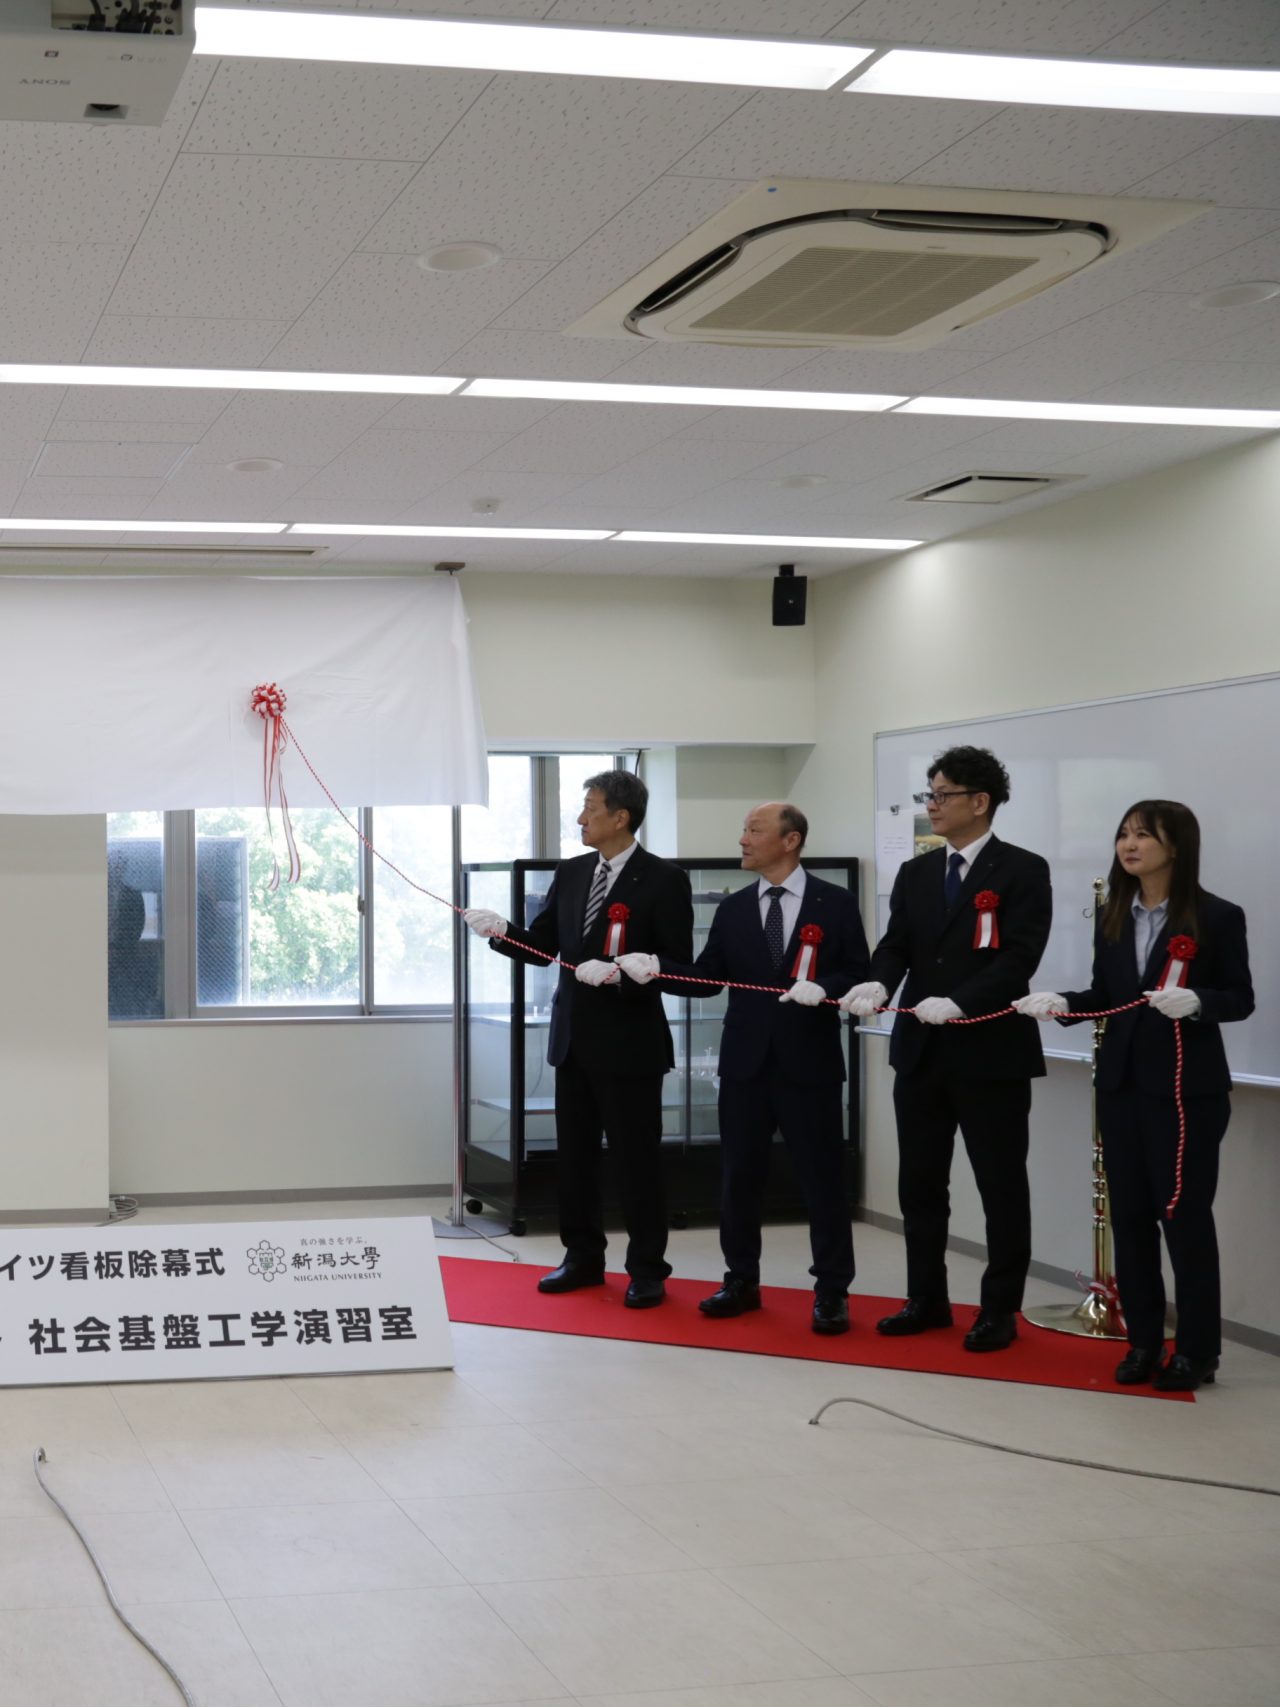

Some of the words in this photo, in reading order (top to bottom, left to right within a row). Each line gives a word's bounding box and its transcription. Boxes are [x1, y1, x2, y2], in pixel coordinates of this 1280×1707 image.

[19, 78, 71, 86] SONY
[294, 1274, 329, 1282] NIIGATA
[332, 1272, 382, 1281] UNIVERSITY
[29, 1304, 418, 1356] 社会基盤工学演習室
